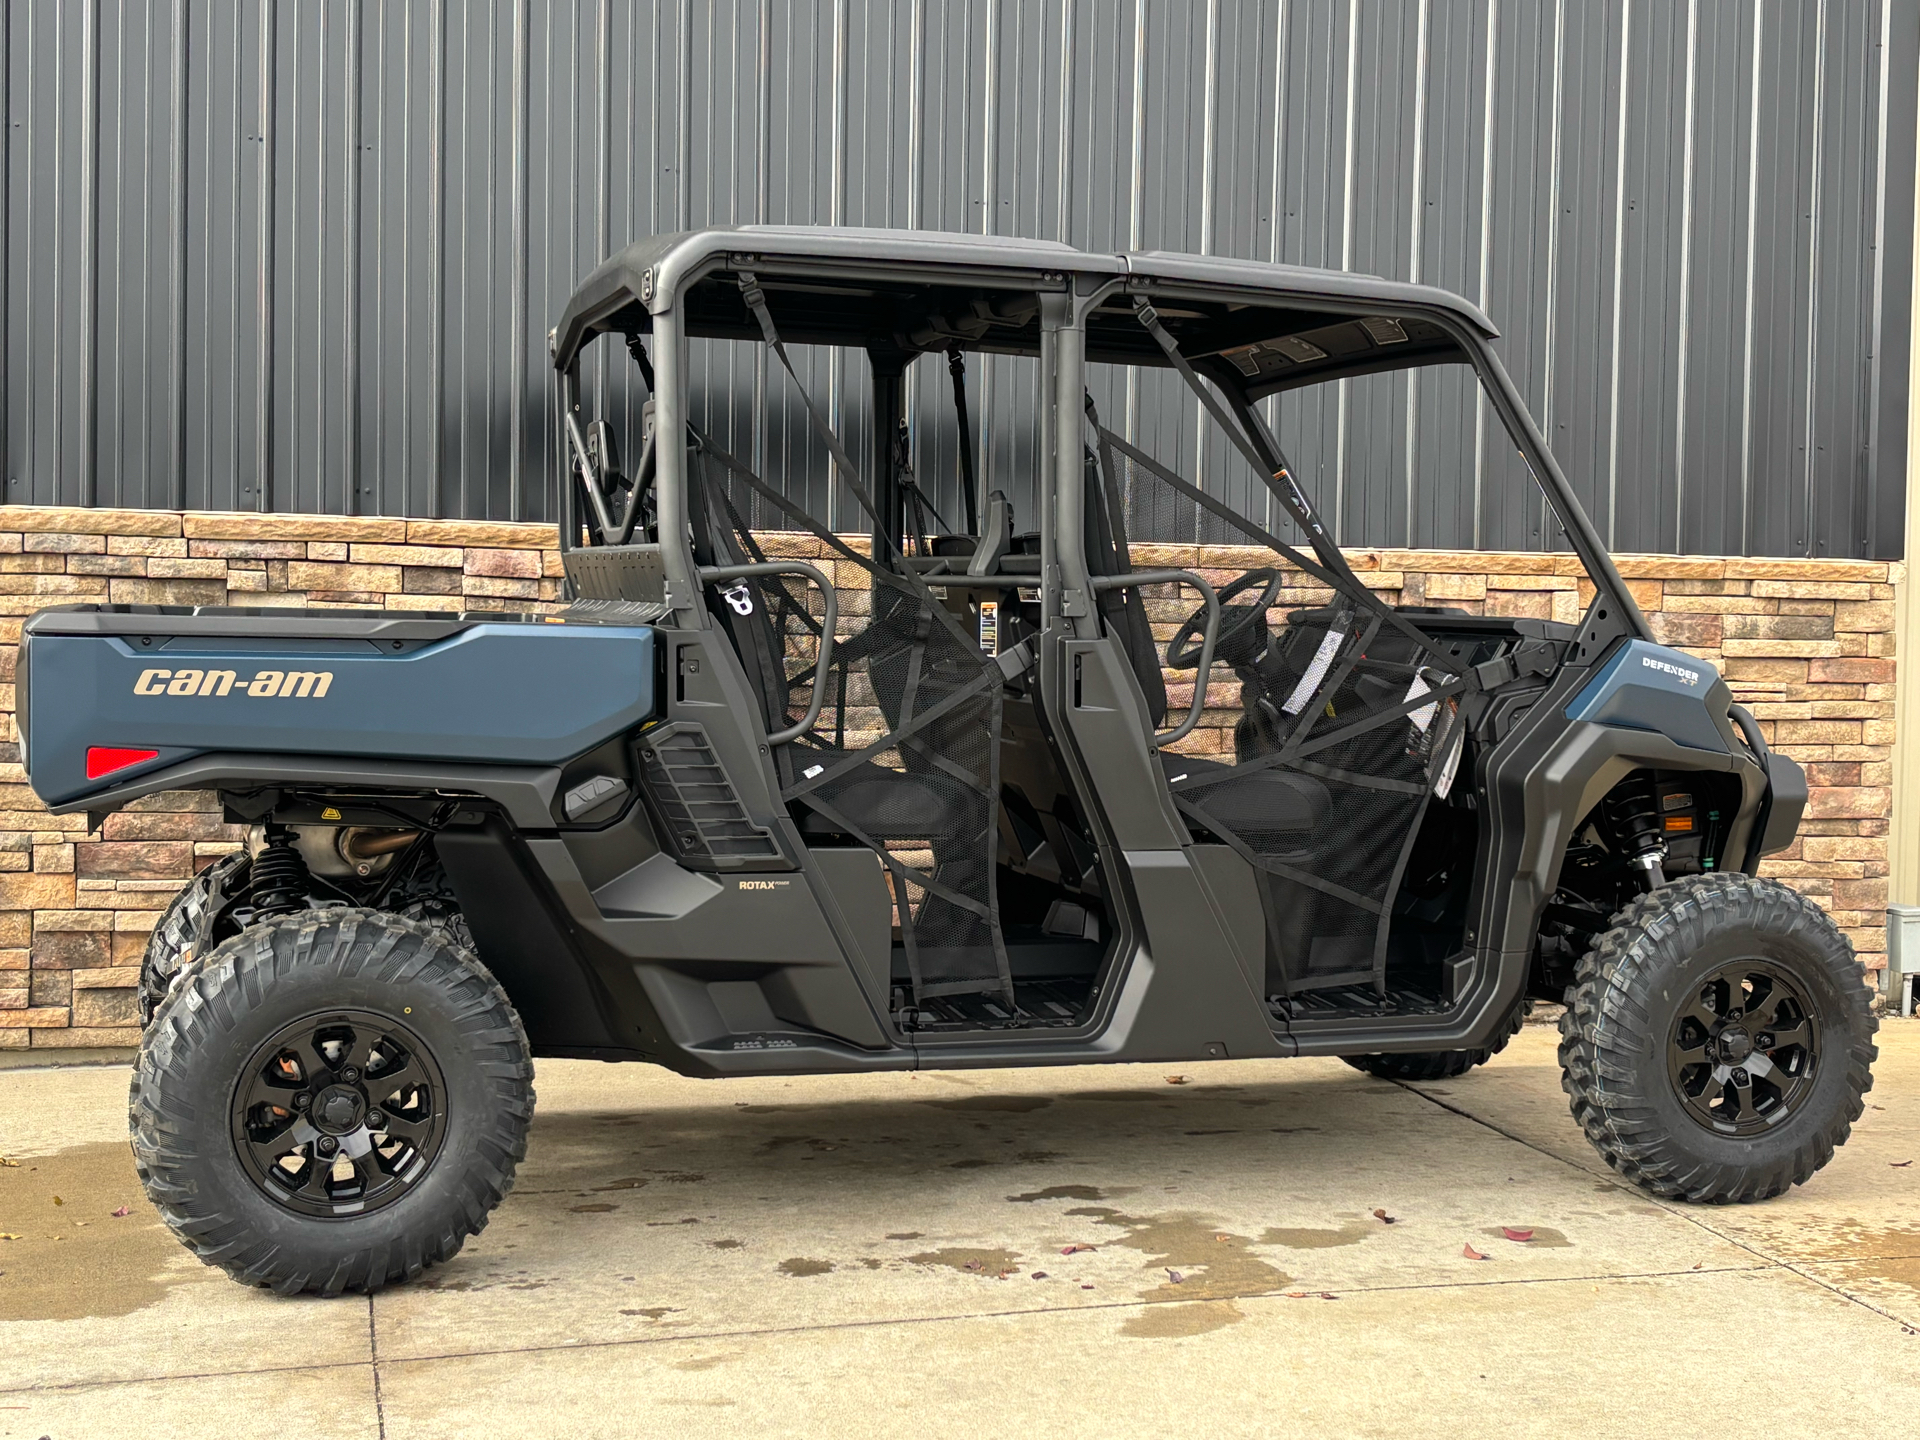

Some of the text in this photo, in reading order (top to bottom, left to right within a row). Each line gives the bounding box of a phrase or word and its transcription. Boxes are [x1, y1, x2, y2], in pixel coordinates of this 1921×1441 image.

[1642, 657, 1699, 681] DEFENDER
[133, 669, 334, 698] can-am
[1679, 678, 1698, 686] XT
[739, 881, 775, 890] ROTAX
